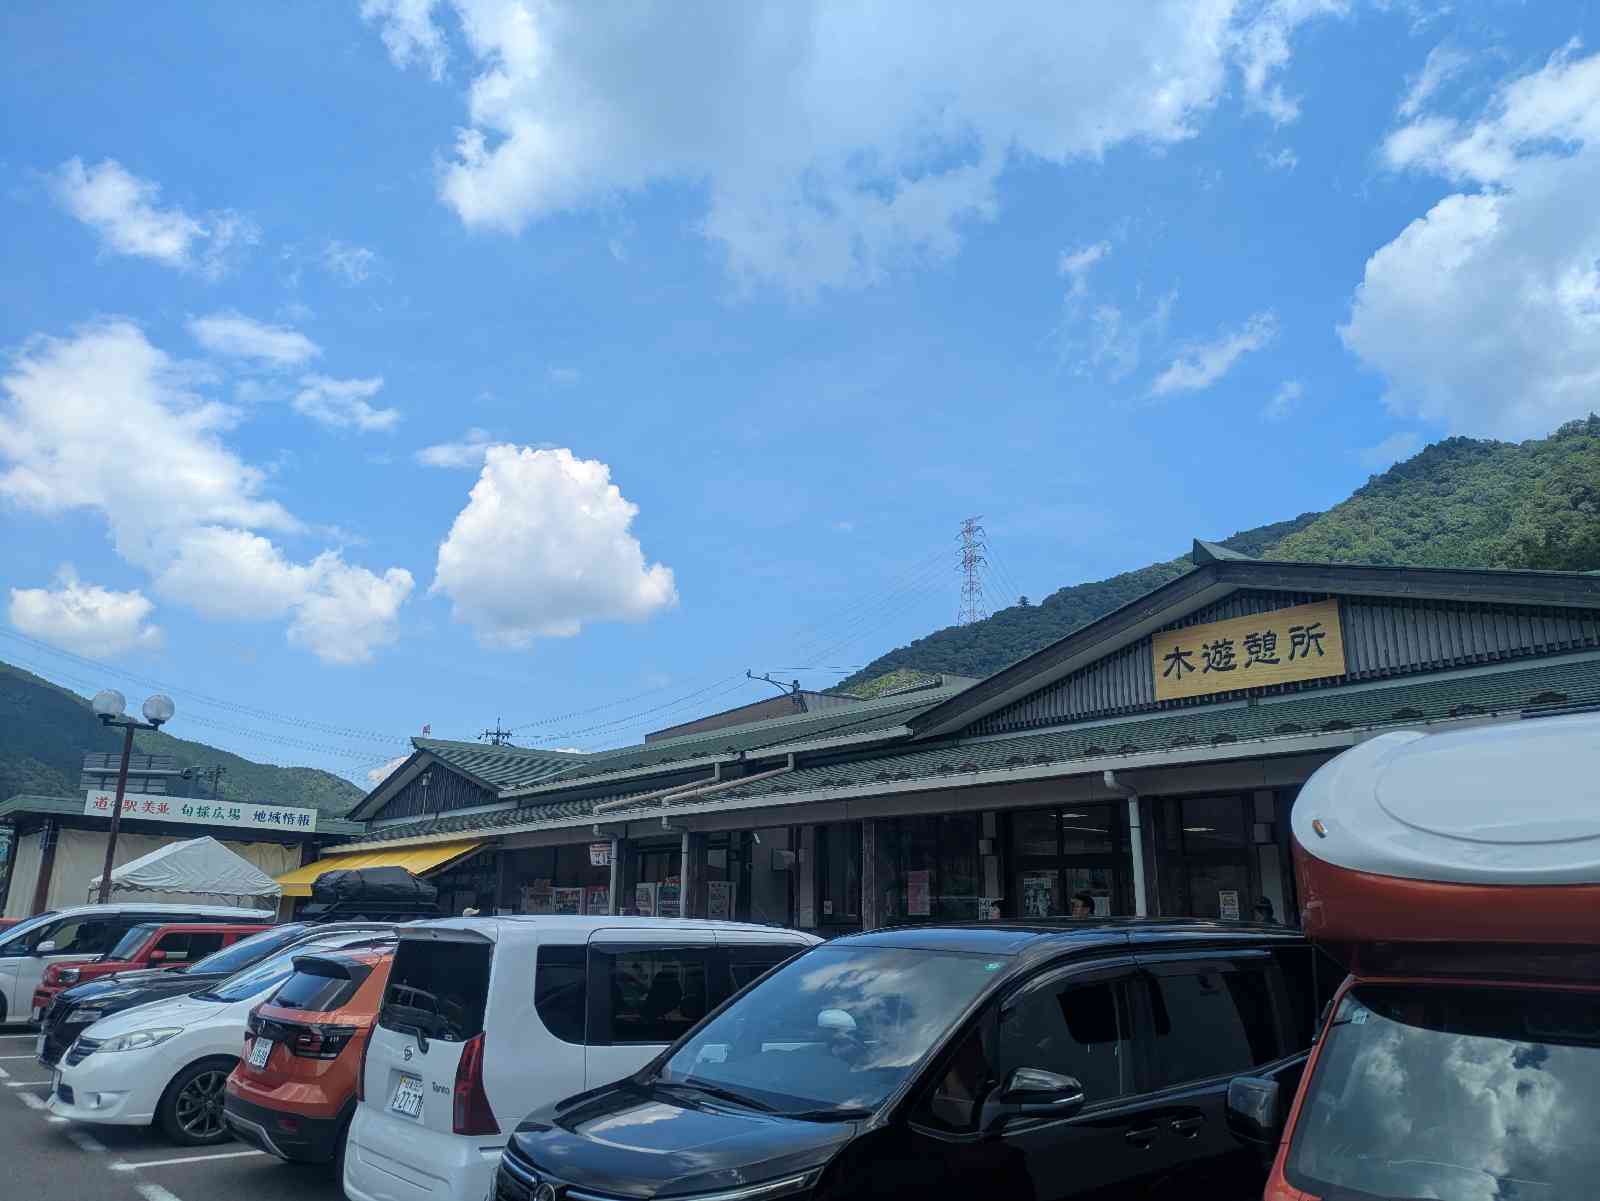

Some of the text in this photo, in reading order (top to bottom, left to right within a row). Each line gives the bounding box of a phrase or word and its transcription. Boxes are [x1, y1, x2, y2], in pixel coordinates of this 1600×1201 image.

[1163, 622, 1326, 680] 木遊憩所
[94, 795, 138, 812] 道駅
[252, 809, 310, 827] 地域情報
